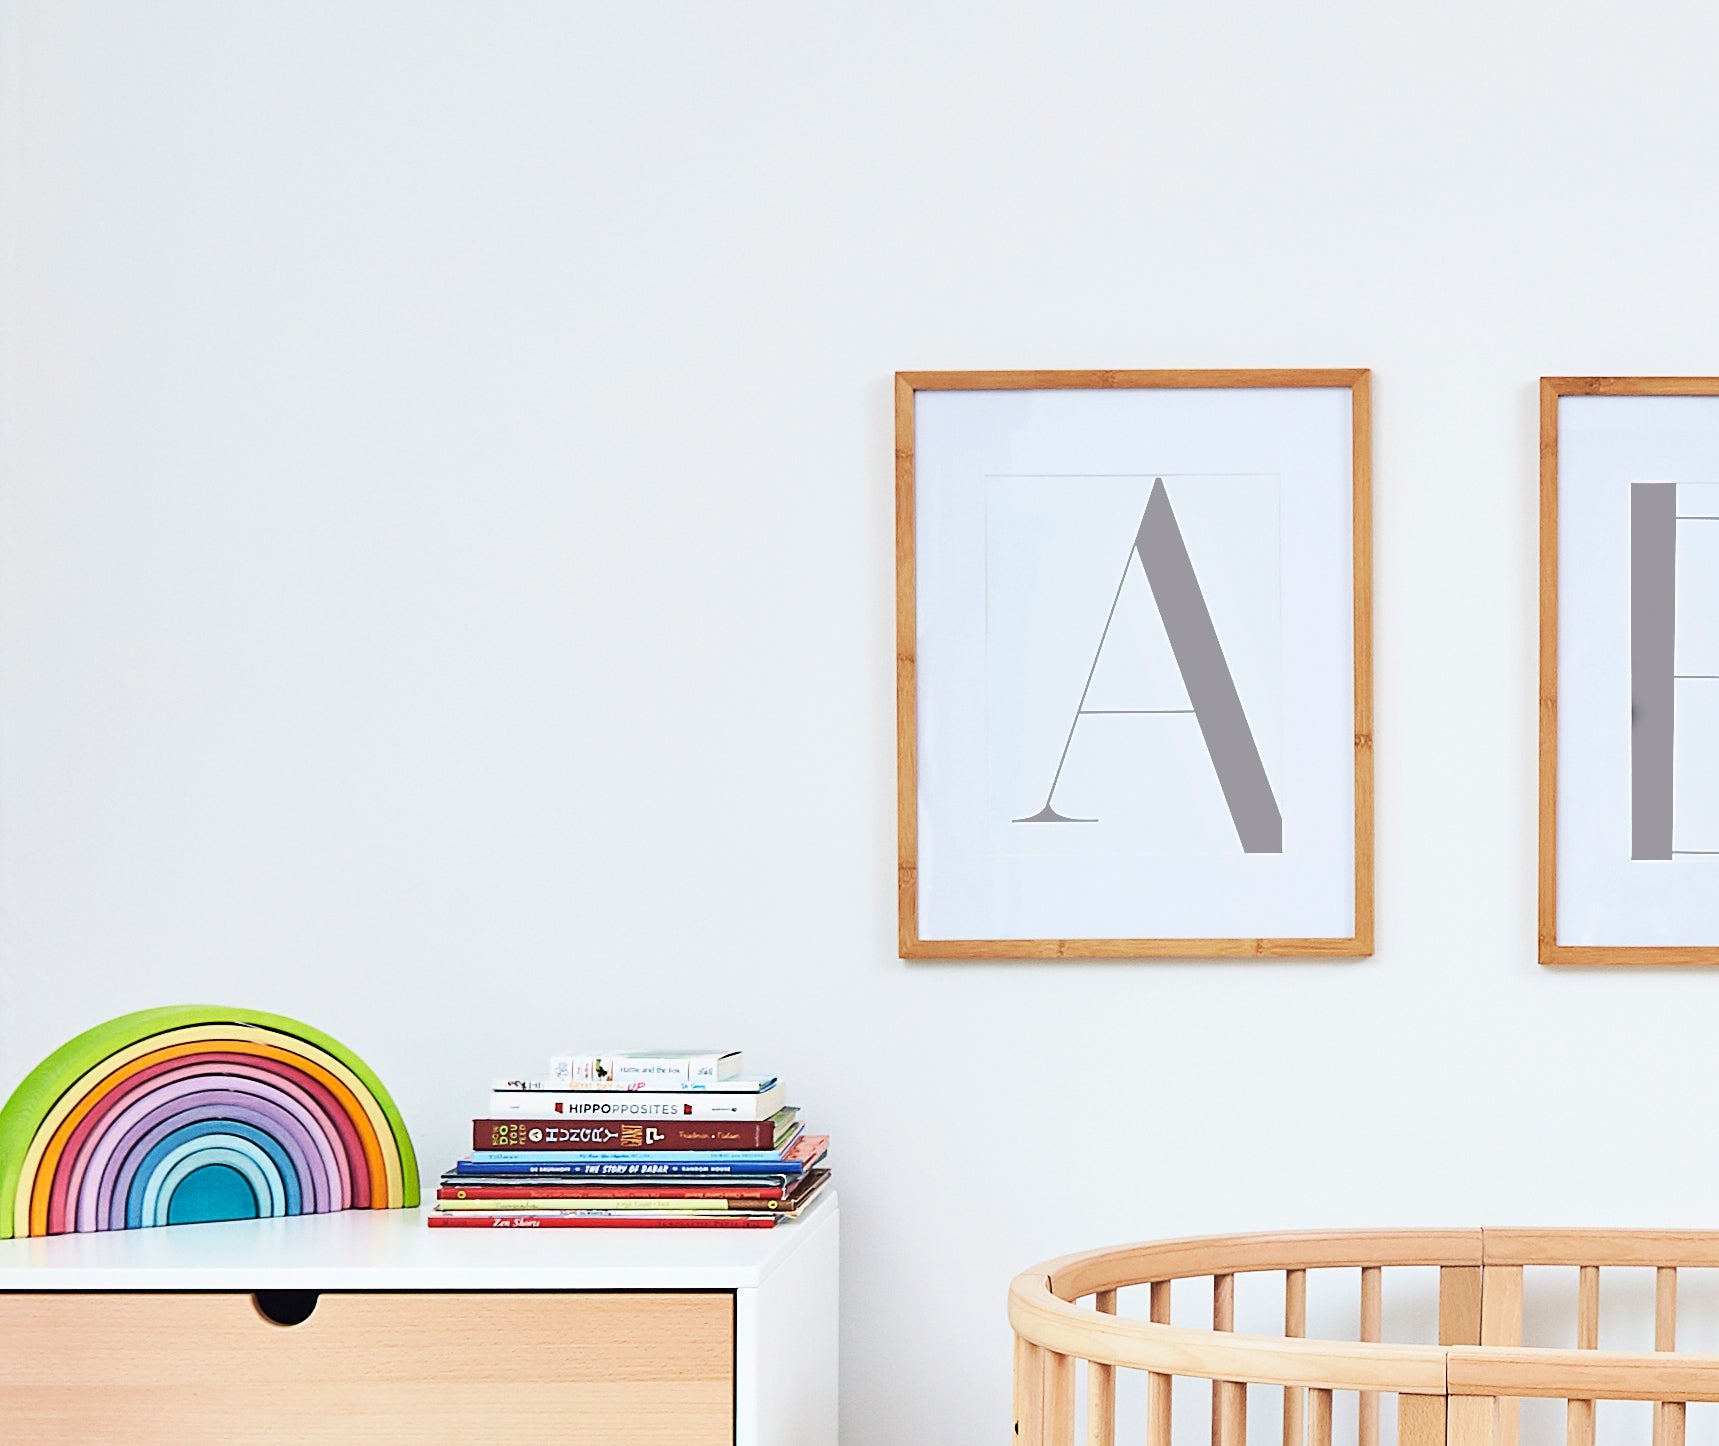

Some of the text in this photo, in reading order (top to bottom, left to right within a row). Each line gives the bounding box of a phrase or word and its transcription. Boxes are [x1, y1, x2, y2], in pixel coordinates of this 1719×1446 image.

[1012, 478, 1282, 853] A
[627, 1082, 646, 1090] UP
[569, 1104, 678, 1114] HIPPOPPOSITES
[500, 1125, 508, 1145] DO
[510, 1124, 518, 1145] YOU
[546, 1127, 619, 1142] HUNGRY
[584, 1165, 669, 1174] THE STORY OF BABAR
[493, 1218, 541, 1227] Zen Shorts
